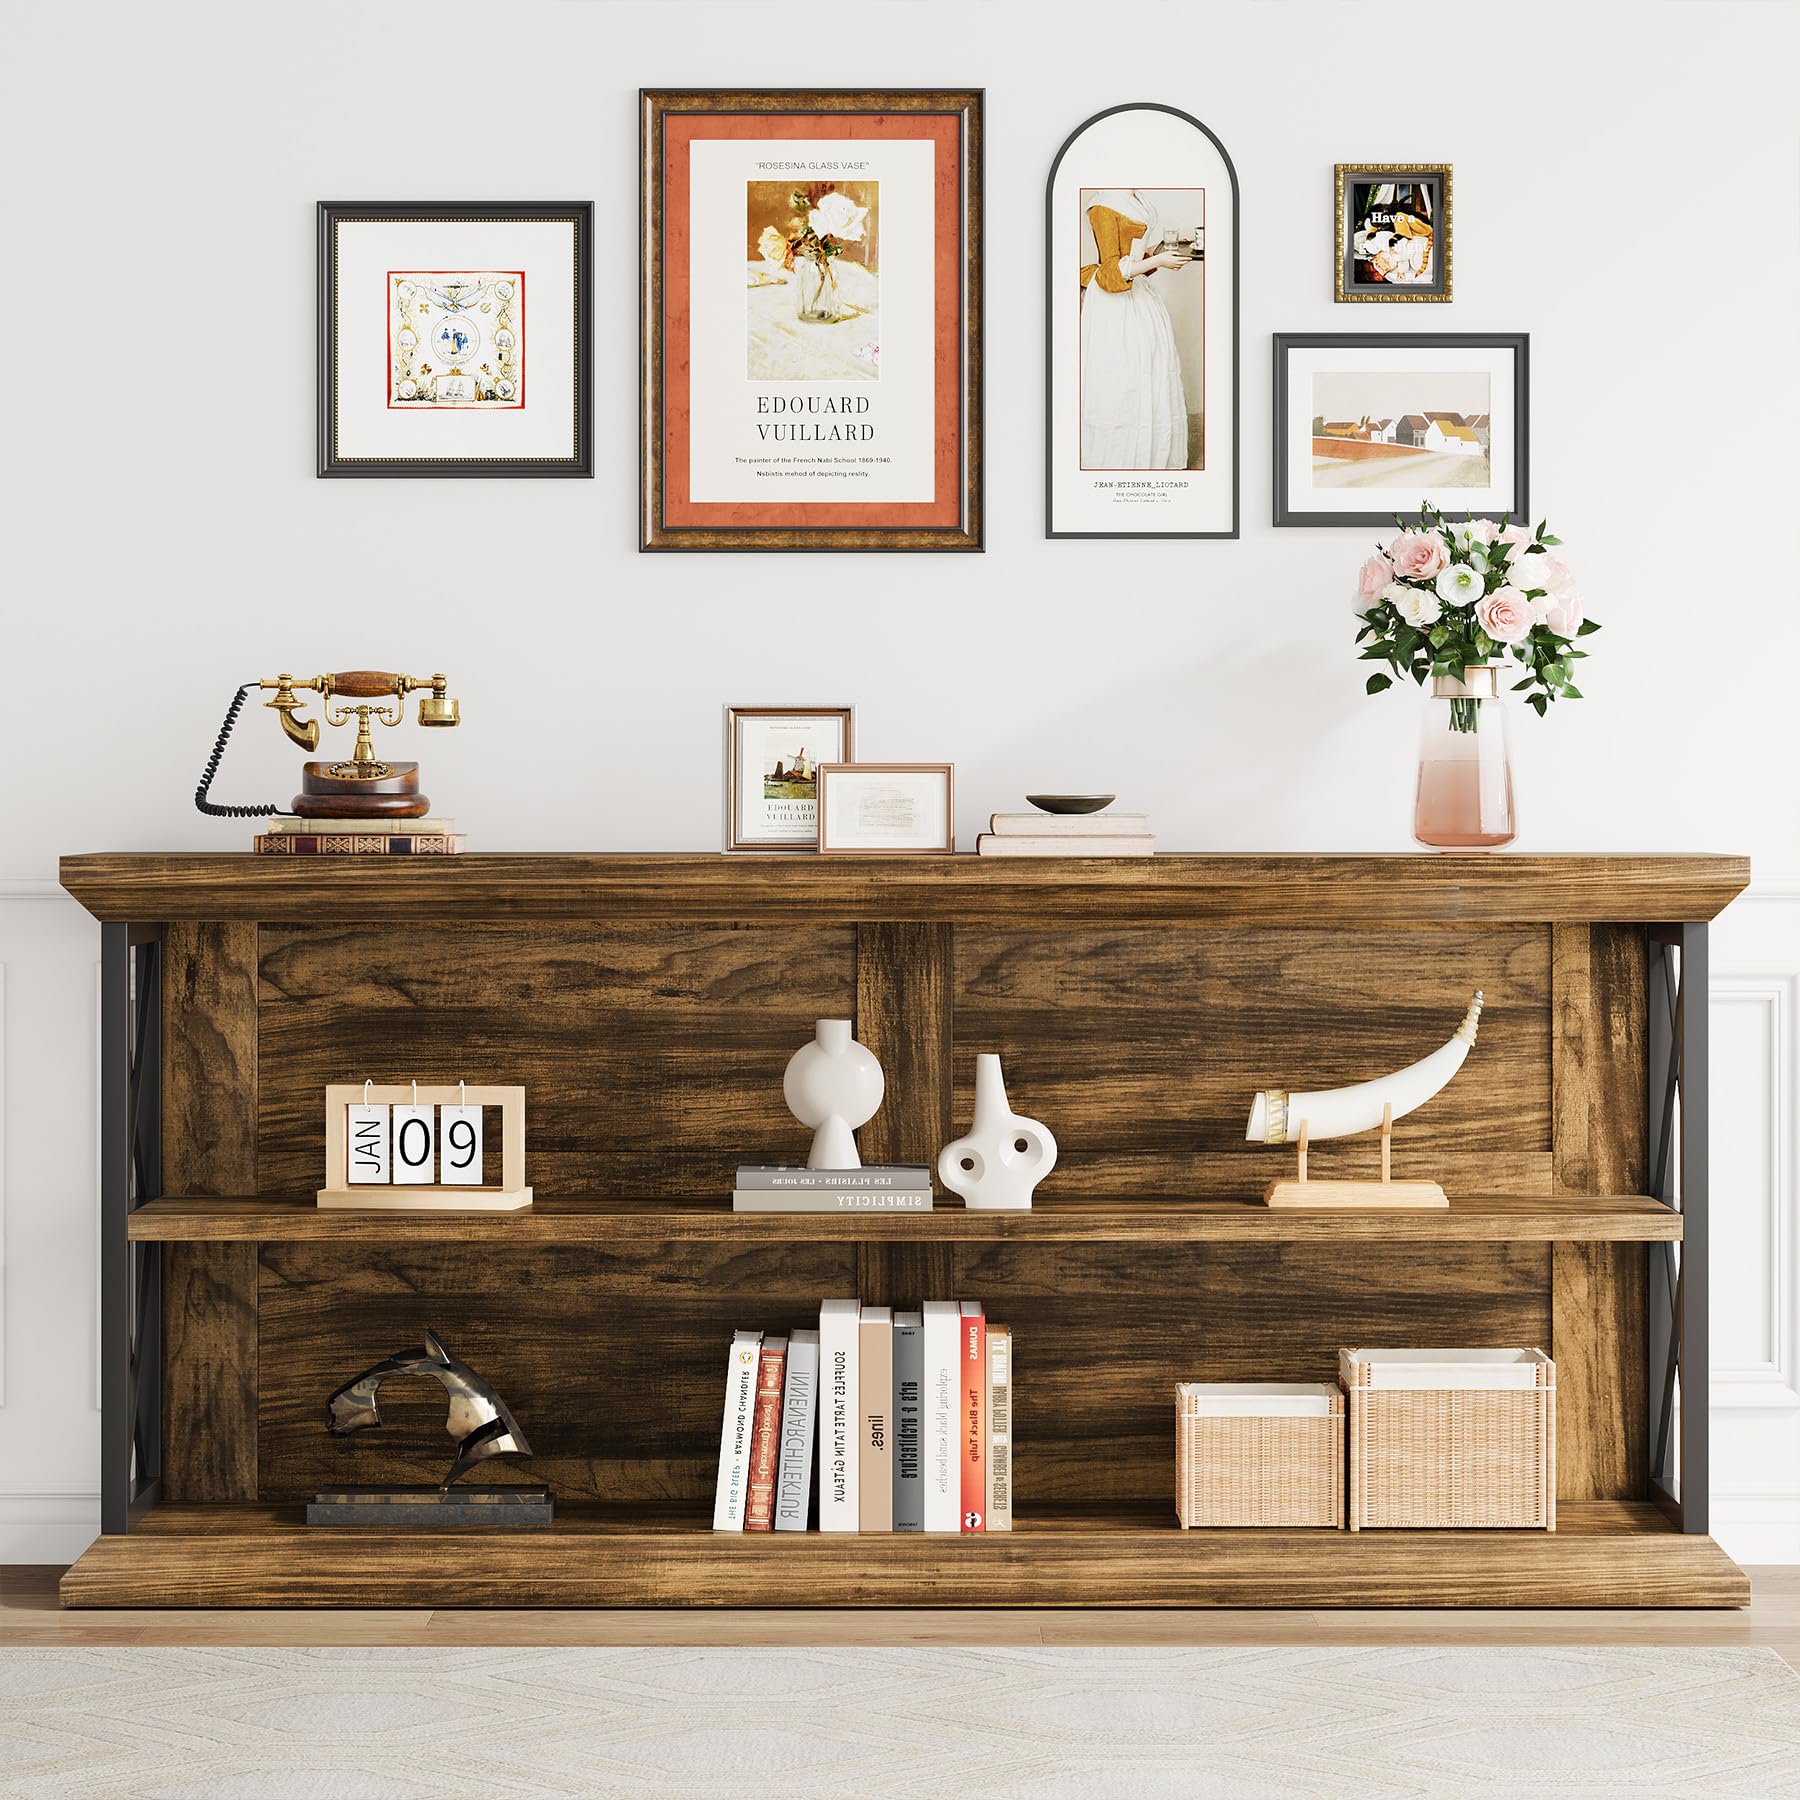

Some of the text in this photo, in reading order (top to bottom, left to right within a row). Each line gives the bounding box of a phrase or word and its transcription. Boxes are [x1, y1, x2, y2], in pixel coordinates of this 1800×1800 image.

[808, 161, 839, 171] GLASS
[1371, 211, 1404, 224] Have
[756, 395, 870, 414] EDOUARD
[756, 423, 875, 442] VUILLARD
[735, 457, 748, 465] The
[748, 457, 772, 466] painter
[772, 456, 781, 465] of
[780, 456, 793, 465] the
[793, 456, 816, 465] French
[817, 456, 833, 465] Nabi
[833, 456, 857, 465] School
[808, 470, 816, 479] of
[816, 470, 847, 480] depicting
[766, 813, 816, 821] VUILLARD
[354, 1120, 382, 1175] JAN
